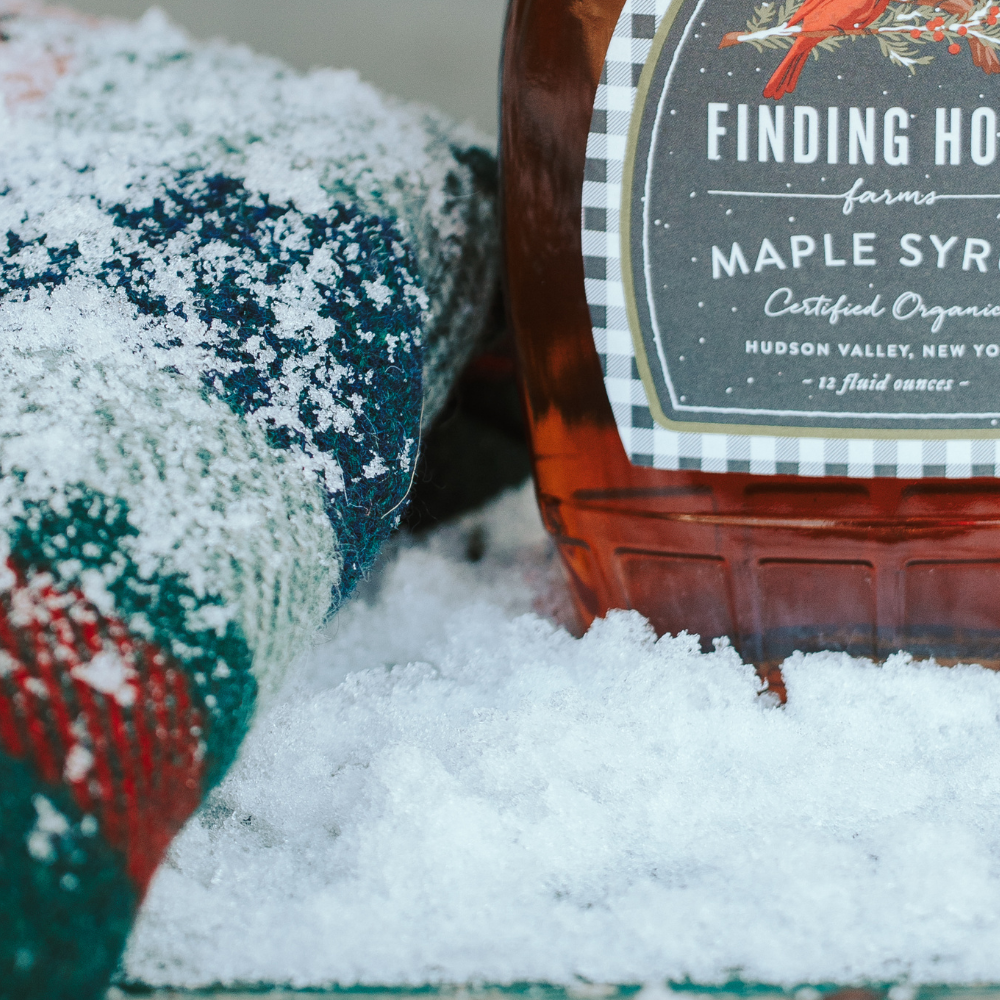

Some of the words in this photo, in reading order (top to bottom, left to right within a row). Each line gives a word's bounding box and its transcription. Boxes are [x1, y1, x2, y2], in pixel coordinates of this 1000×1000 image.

[707, 102, 909, 166] FINDING
[842, 177, 937, 215] farms
[711, 232, 877, 280] MAPLE
[764, 287, 885, 325] Certified
[745, 340, 830, 357] HUDSON
[838, 343, 914, 360] VALLEY,
[923, 344, 965, 358] NEW
[818, 376, 836, 390] 12
[836, 372, 891, 395] fluid
[893, 378, 953, 392] ounces
